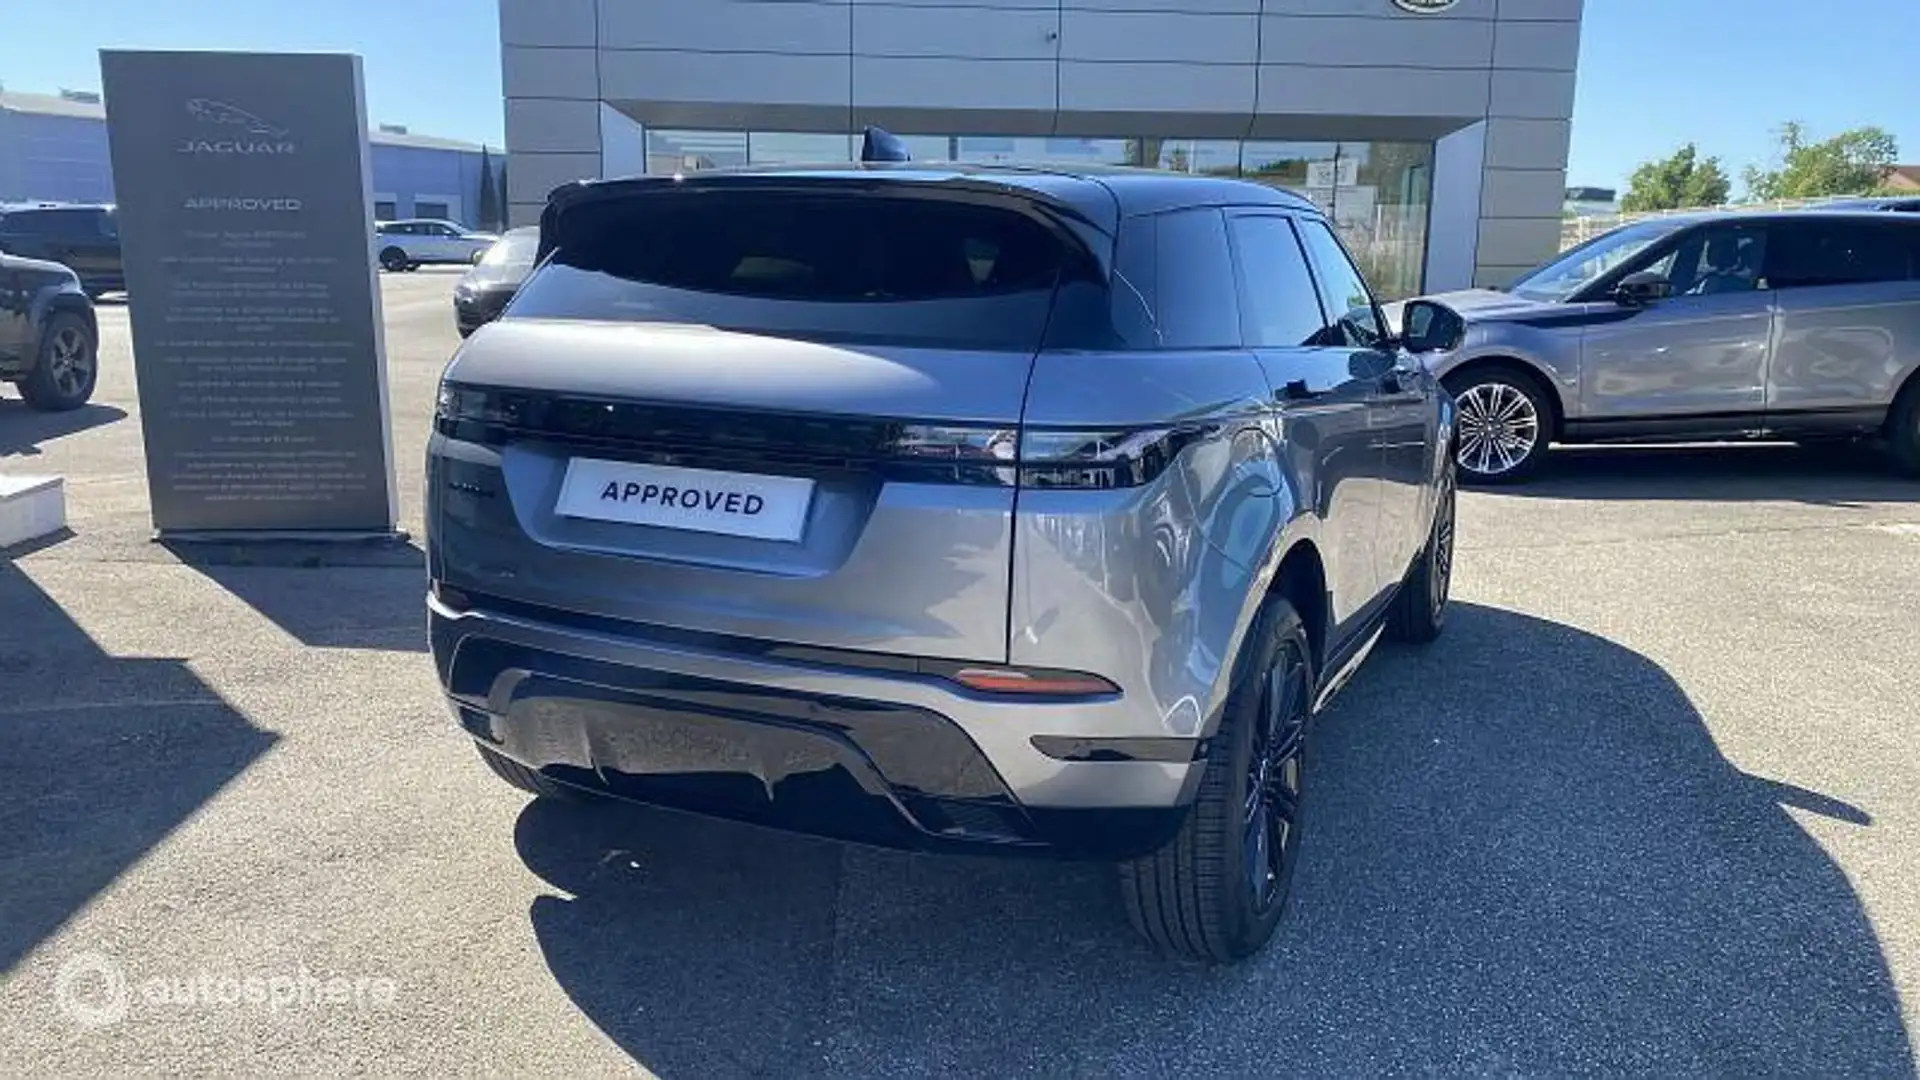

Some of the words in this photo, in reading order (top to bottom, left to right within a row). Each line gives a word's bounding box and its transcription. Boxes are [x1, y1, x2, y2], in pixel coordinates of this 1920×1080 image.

[177, 141, 295, 154] JAGUAR
[184, 198, 302, 210] APPROVED
[601, 482, 764, 515] APPROVED
